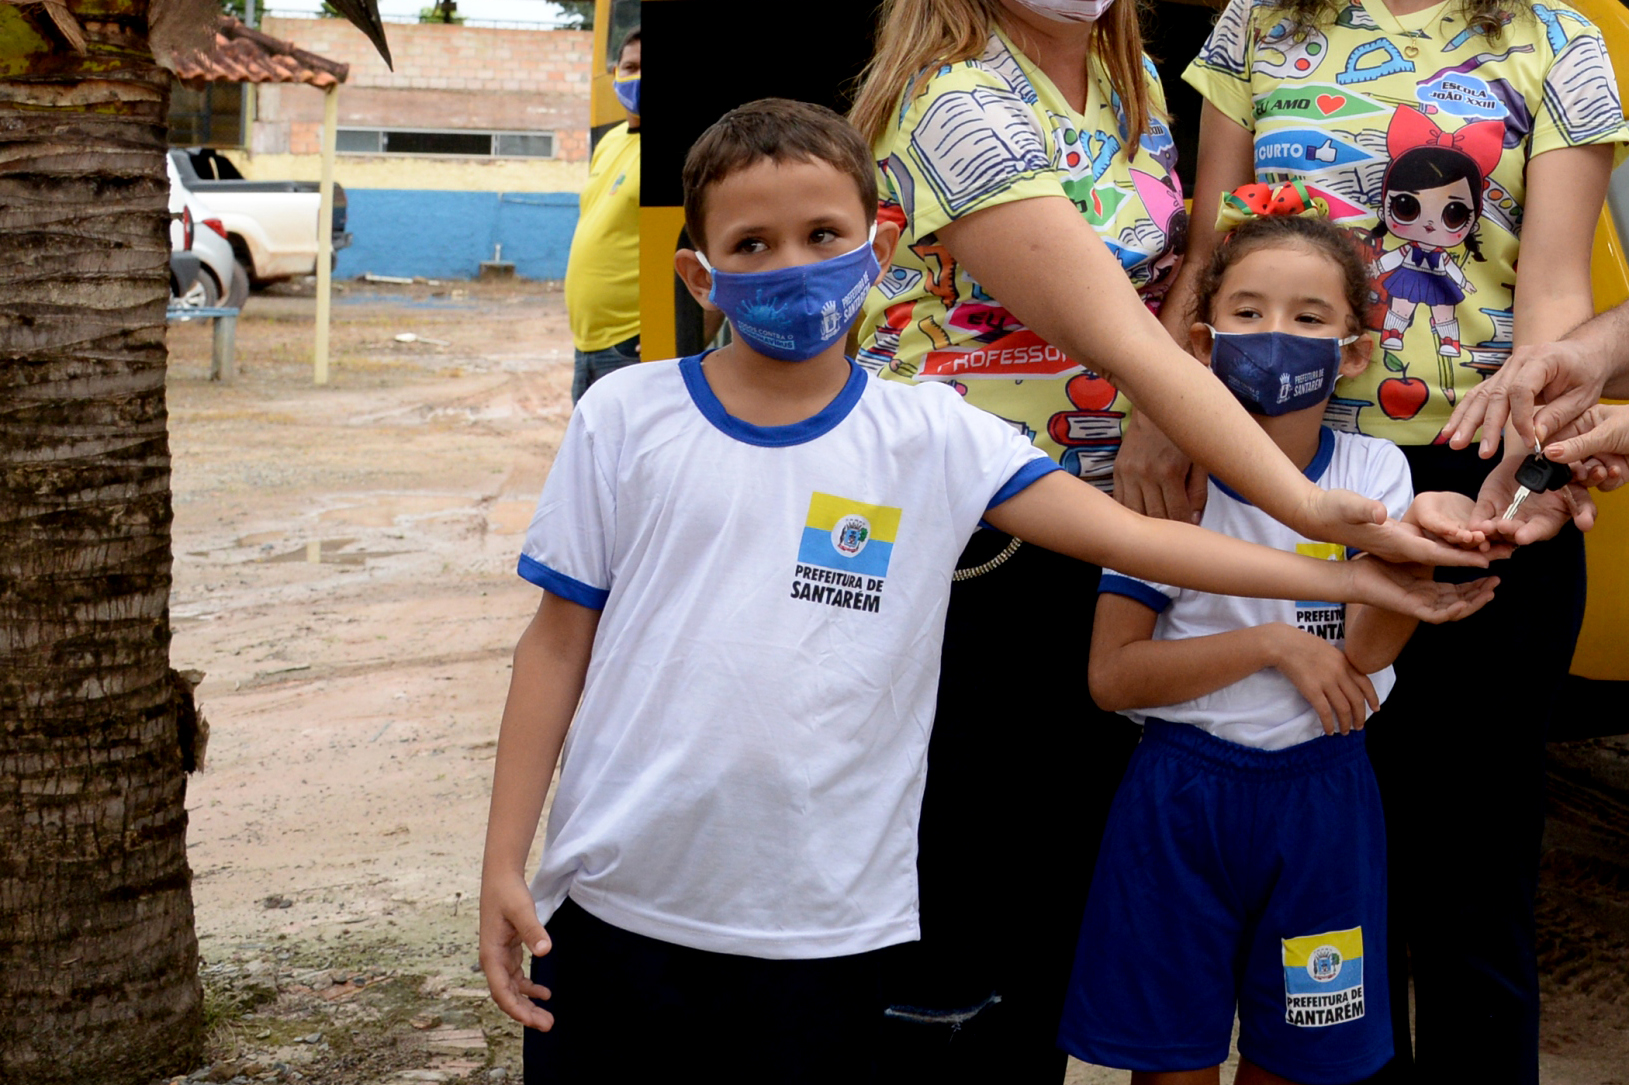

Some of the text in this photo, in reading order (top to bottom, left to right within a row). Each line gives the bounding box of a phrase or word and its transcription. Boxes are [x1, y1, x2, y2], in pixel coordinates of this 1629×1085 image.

[1442, 81, 1487, 98] ESCOLA
[1271, 98, 1311, 110] AMO
[1466, 97, 1496, 109] XXIII
[1259, 143, 1304, 161] CURTO
[795, 564, 884, 593] PREFEITURA DE
[790, 580, 881, 614] SANTARÉM
[1287, 987, 1363, 1008] PREFEITURA DE
[1287, 1001, 1364, 1026] SANTARÉM
